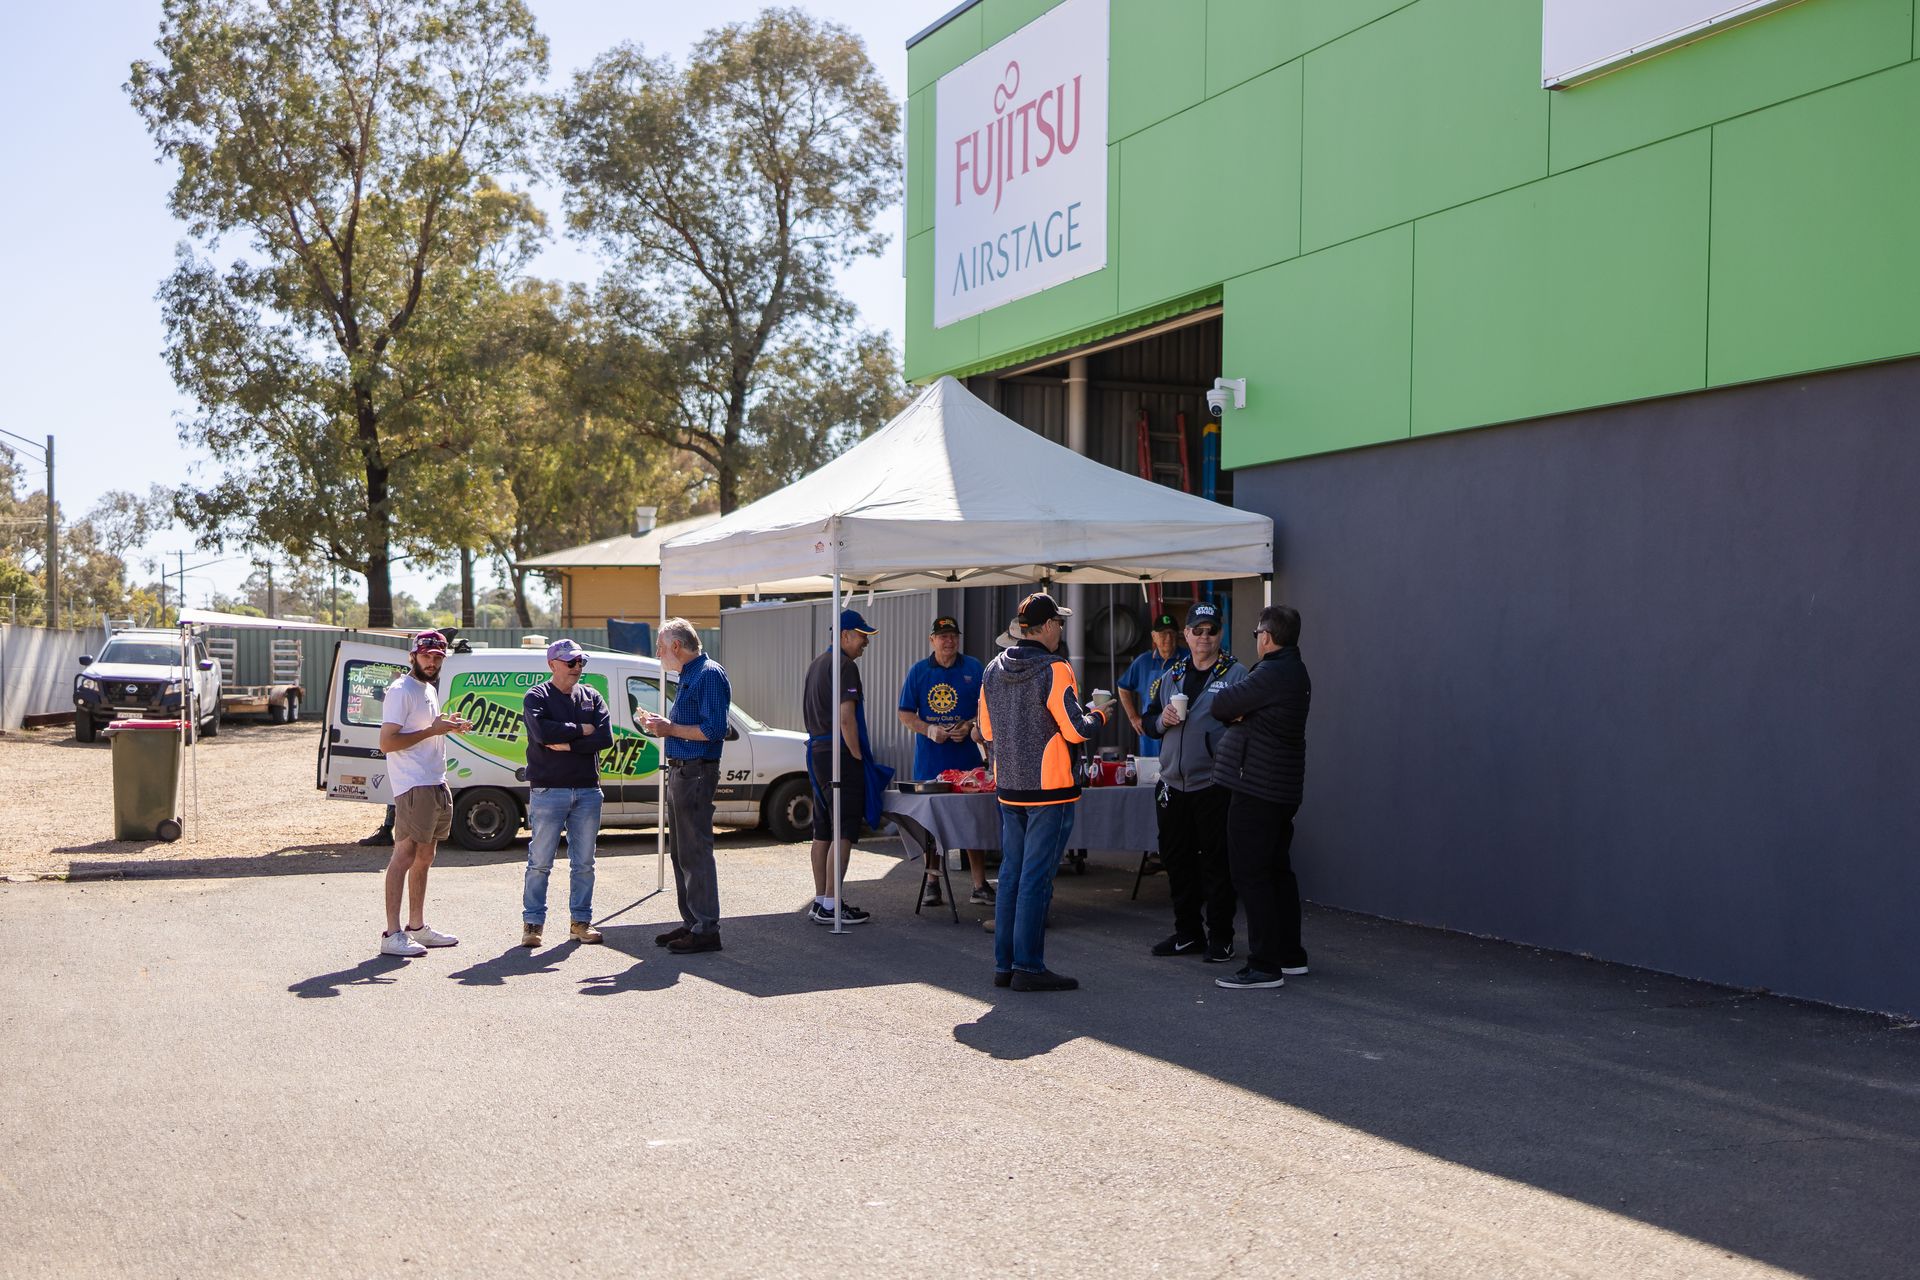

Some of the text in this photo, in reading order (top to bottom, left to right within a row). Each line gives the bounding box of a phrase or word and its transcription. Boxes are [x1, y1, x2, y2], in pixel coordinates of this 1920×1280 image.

[955, 74, 1082, 214] FUJITSU
[953, 202, 1081, 296] AIRSTAGE
[465, 672, 509, 687] AWAY
[515, 673, 544, 687] CUP
[456, 692, 525, 742] COFFEE
[726, 769, 751, 781] 547
